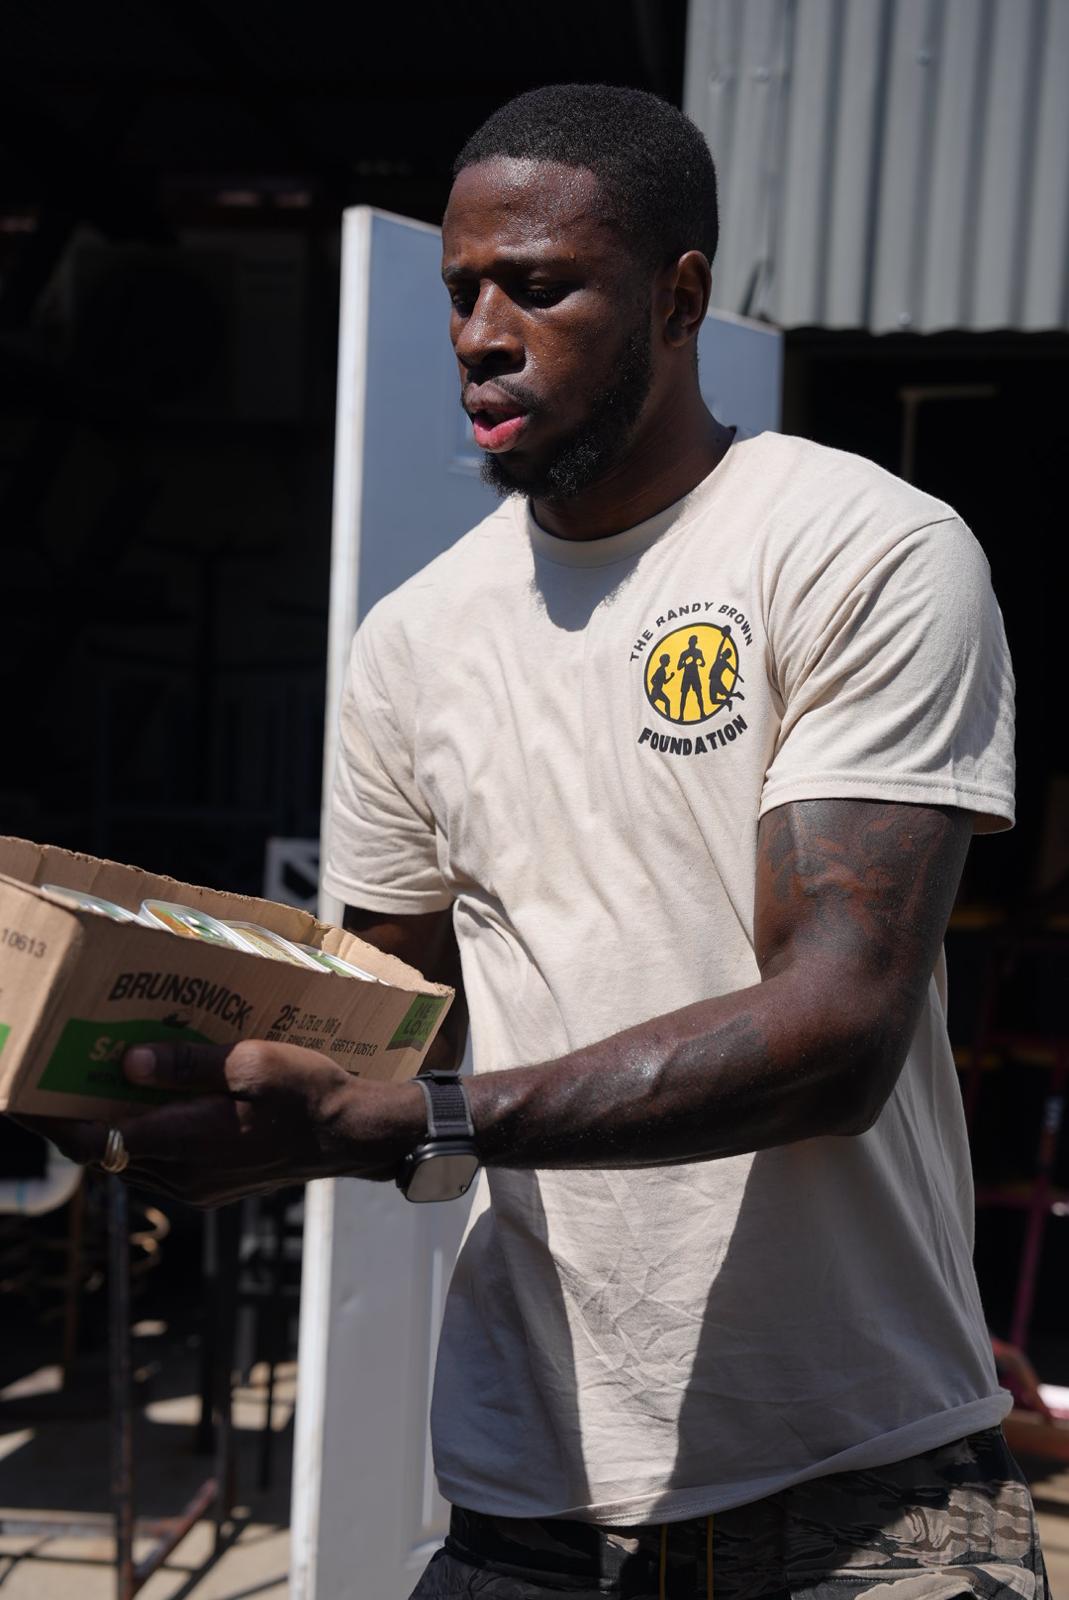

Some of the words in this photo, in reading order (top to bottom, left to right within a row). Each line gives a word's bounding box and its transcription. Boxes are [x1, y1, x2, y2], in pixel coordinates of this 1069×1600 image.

[630, 629, 653, 662] THE
[655, 601, 714, 628] RANDY
[717, 604, 753, 647] BROWN
[637, 714, 748, 756] FOUNDATION
[108, 971, 253, 1030] BRUNSWICK
[271, 1004, 300, 1032] 25
